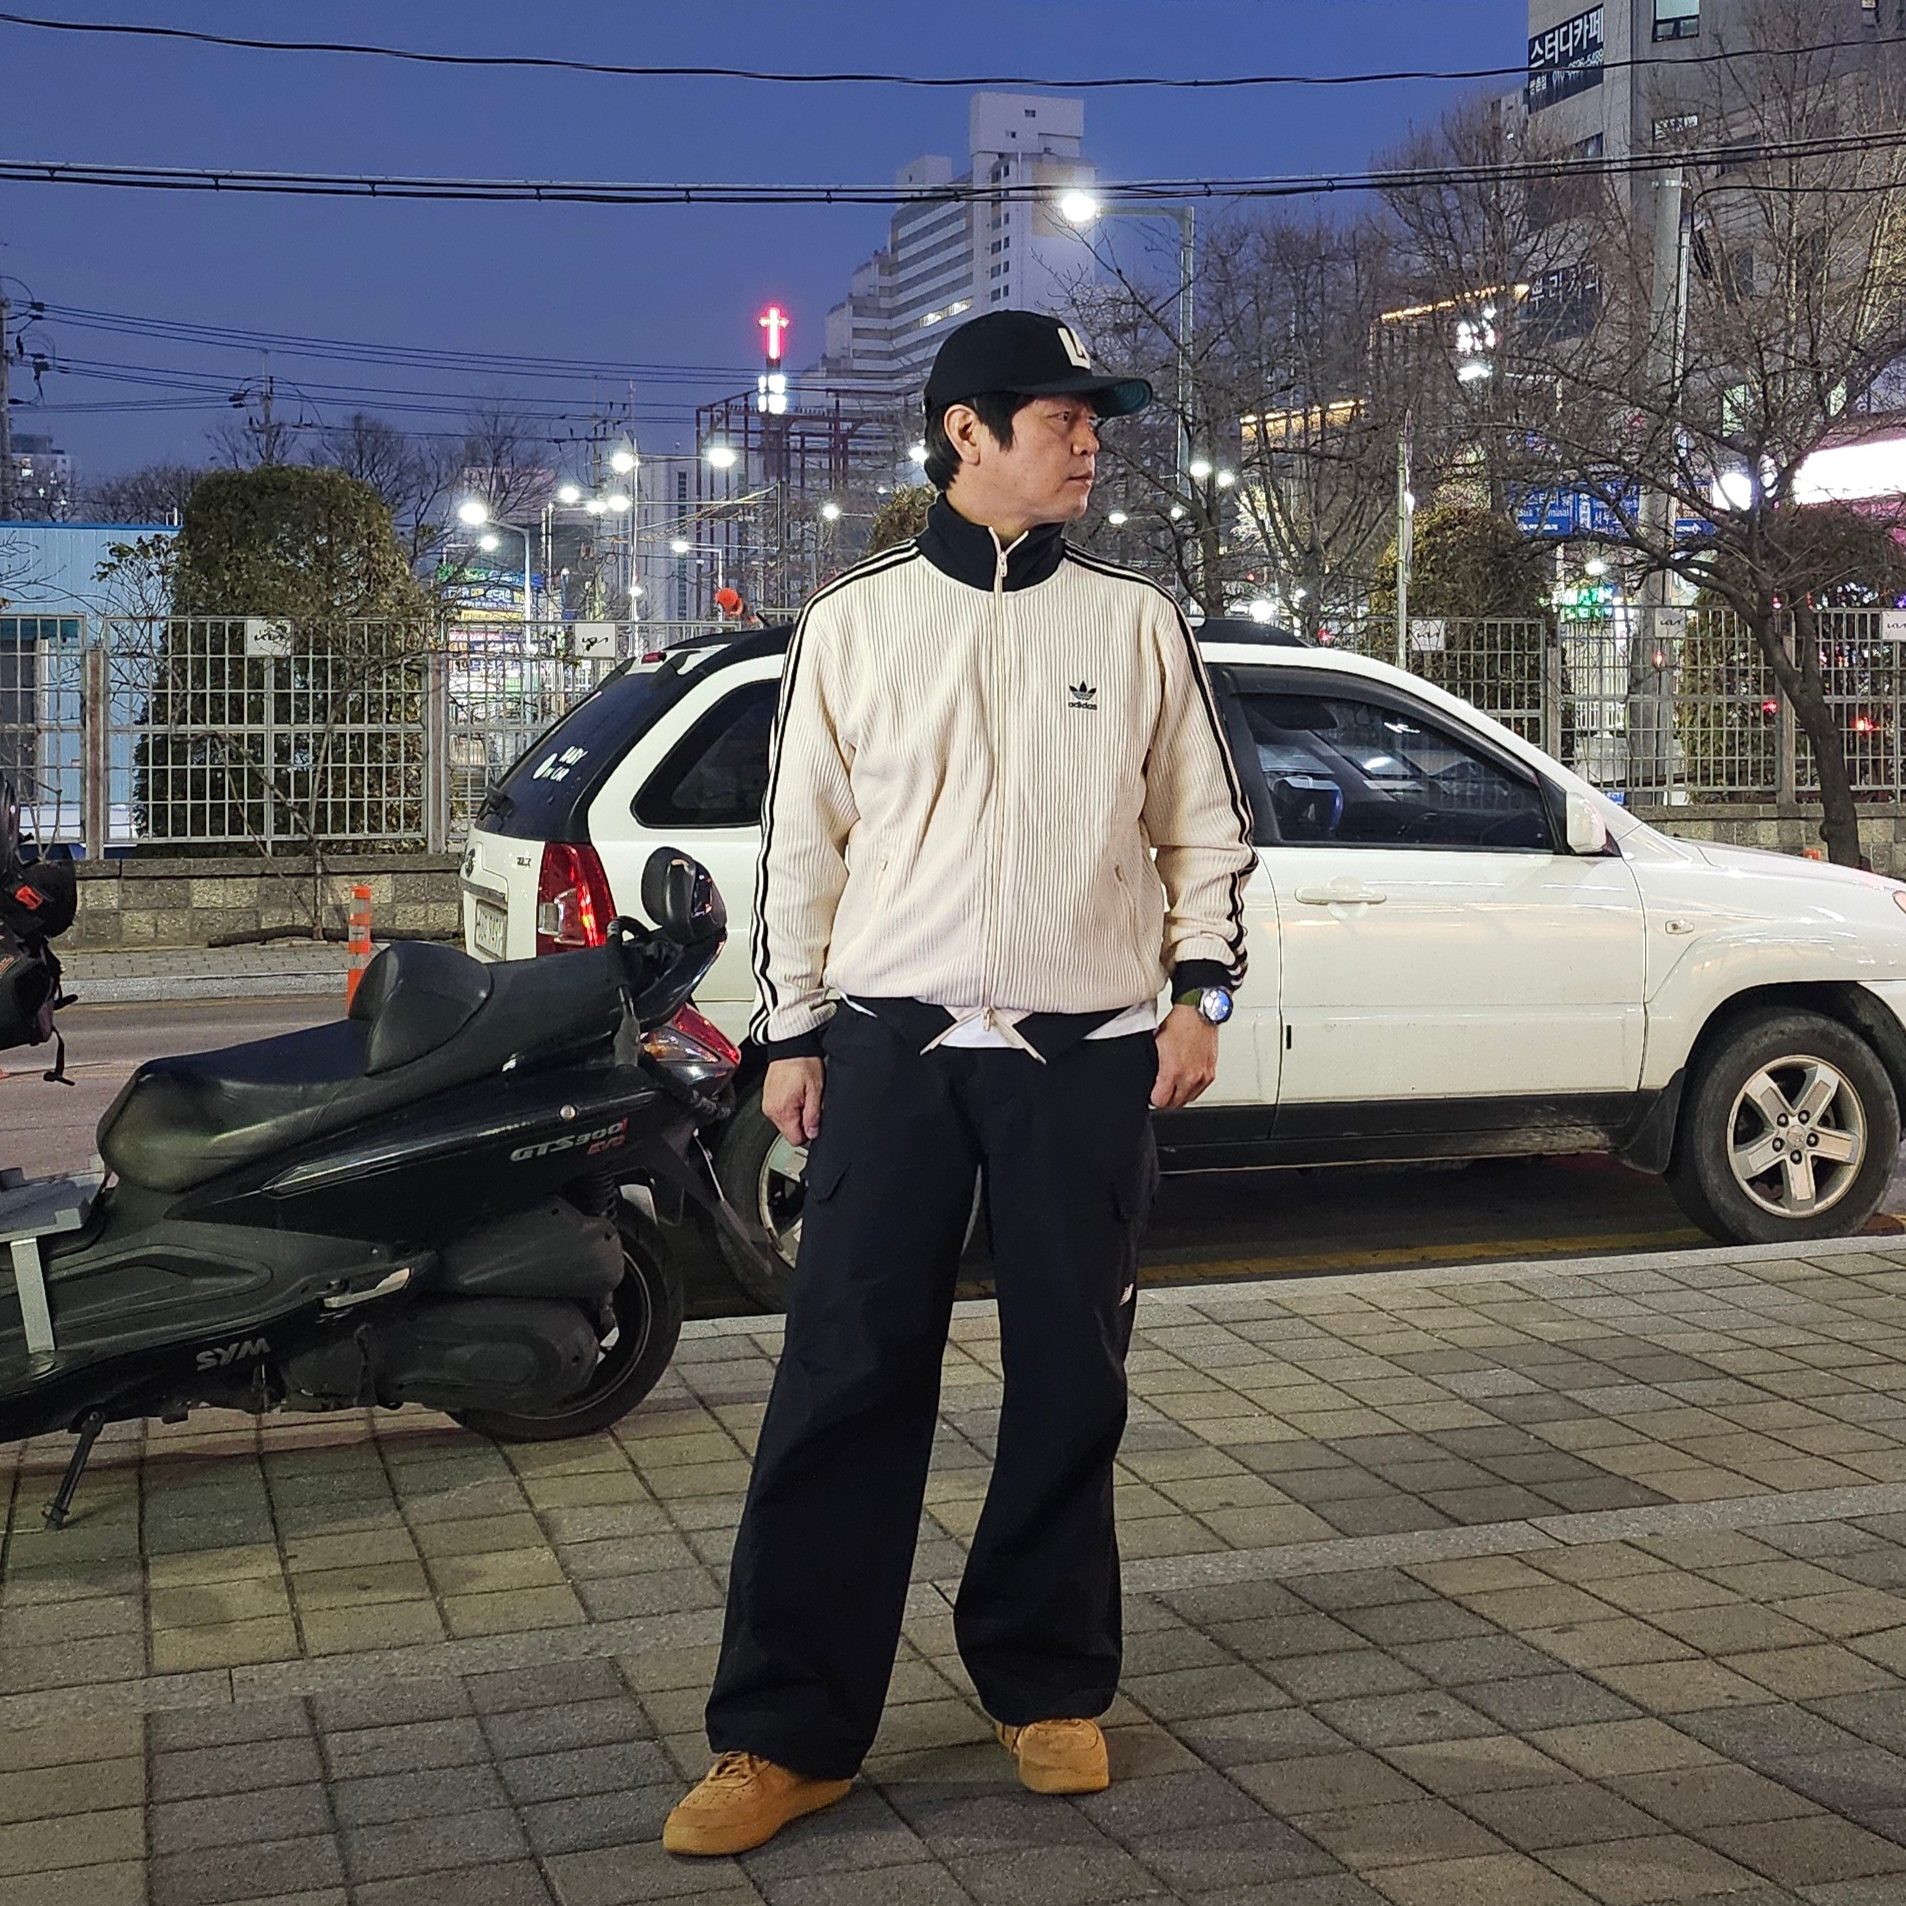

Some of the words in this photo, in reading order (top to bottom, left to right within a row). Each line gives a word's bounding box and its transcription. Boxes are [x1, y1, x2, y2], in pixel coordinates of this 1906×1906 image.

[1530, 7, 1604, 68] 스터디카페
[1068, 701, 1098, 711] adidas
[196, 1337, 271, 1371] SYM
